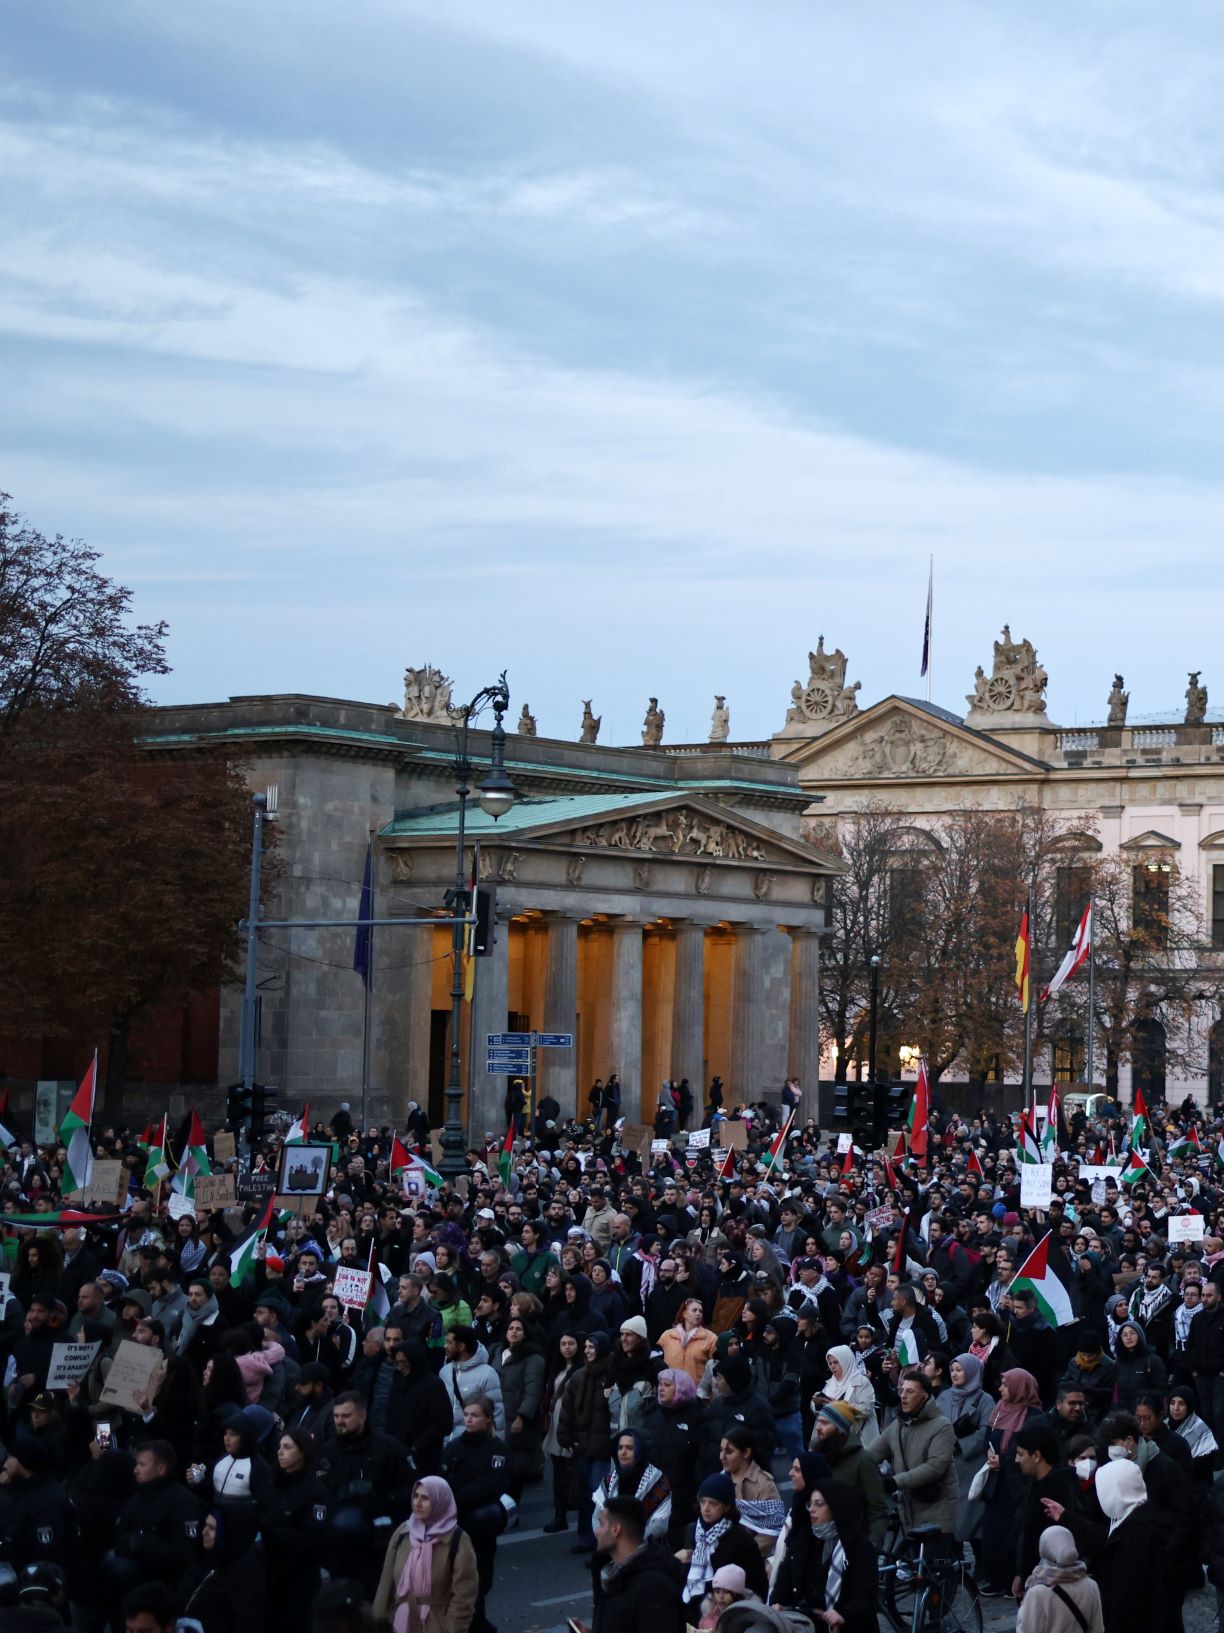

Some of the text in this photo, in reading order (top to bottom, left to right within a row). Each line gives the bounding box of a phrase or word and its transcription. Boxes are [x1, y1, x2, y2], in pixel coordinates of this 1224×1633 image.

[251, 1174, 269, 1182] FREE
[239, 1184, 277, 1192] PALESTINE
[35, 1393, 43, 1401] P
